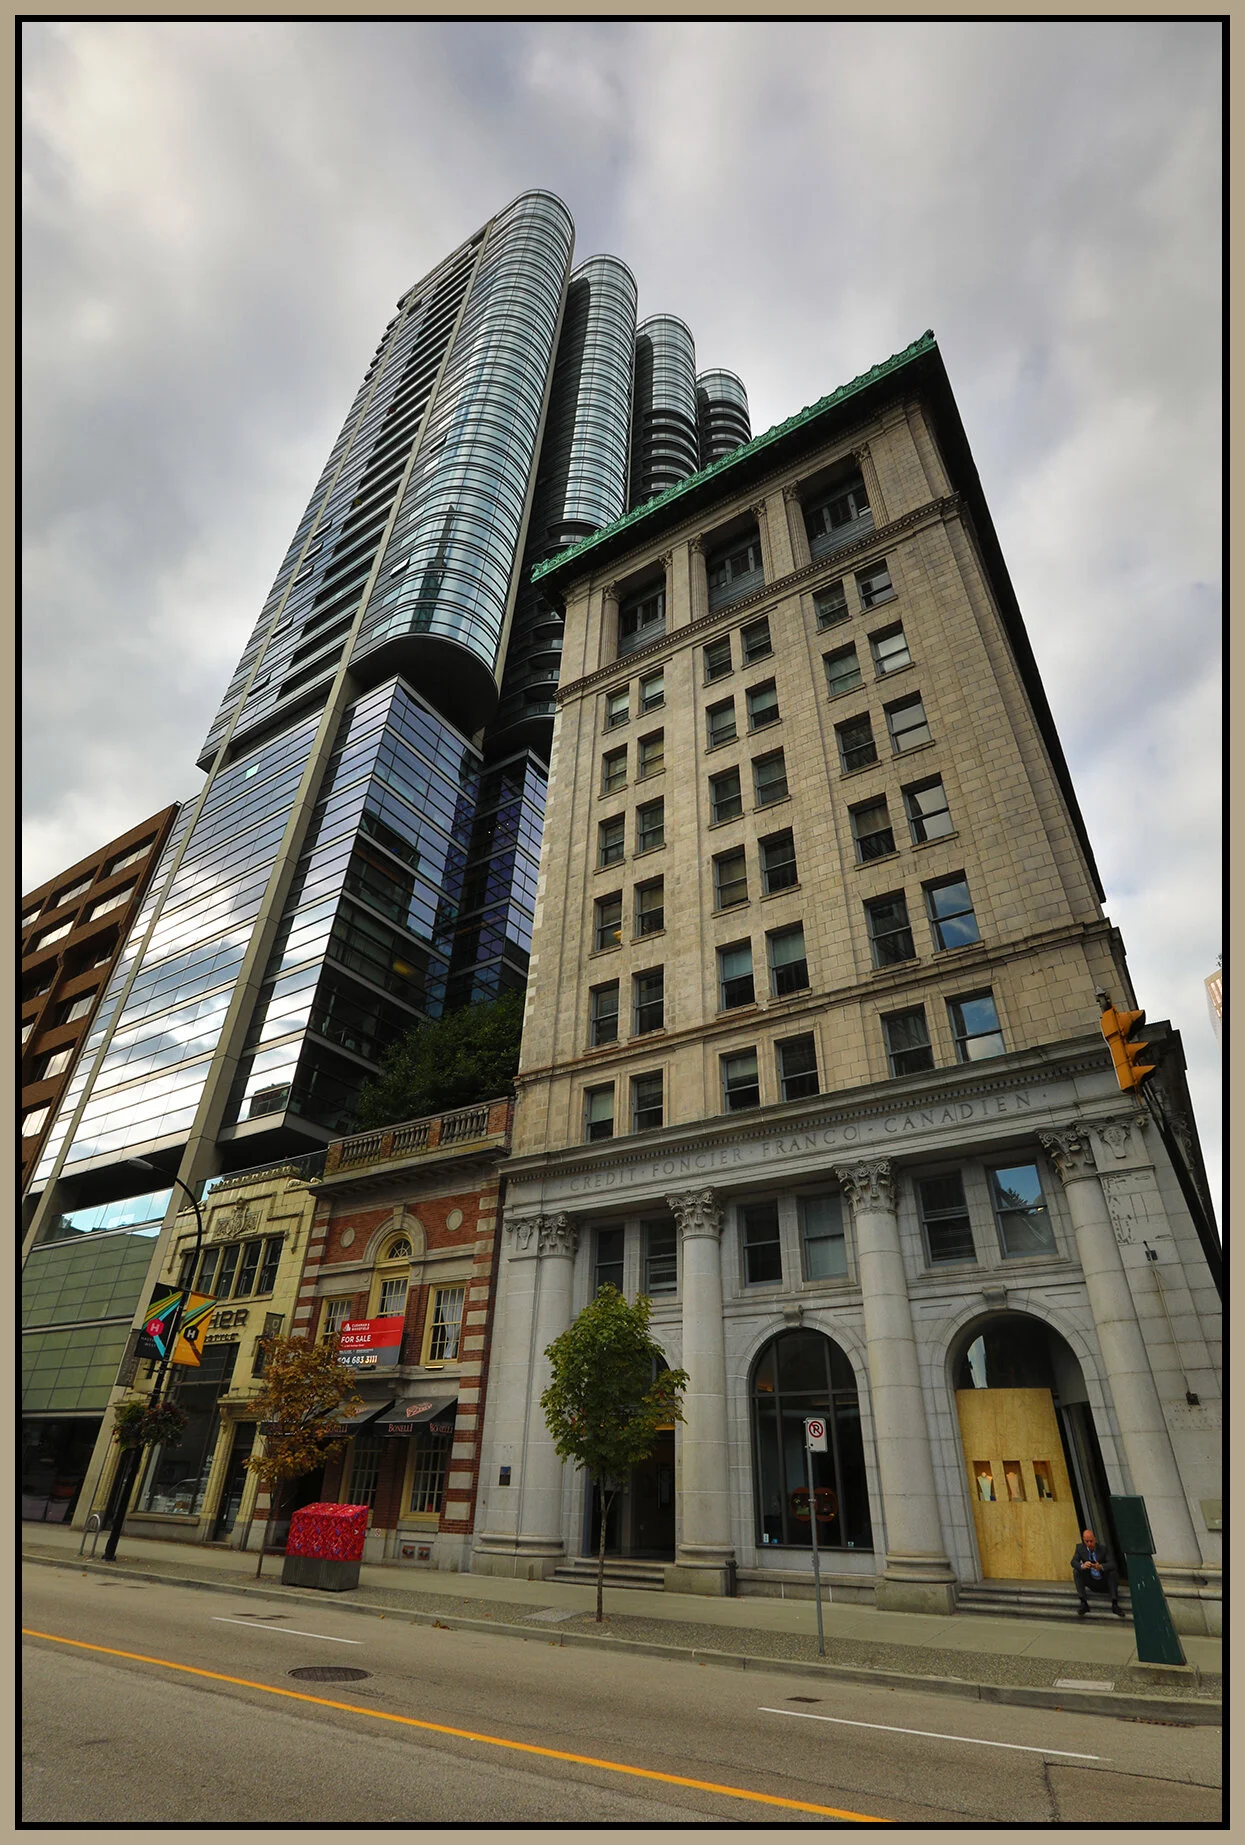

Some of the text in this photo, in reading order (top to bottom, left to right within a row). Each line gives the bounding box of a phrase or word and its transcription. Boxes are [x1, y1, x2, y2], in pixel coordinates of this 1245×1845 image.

[569, 1090, 1033, 1192] CREDIT FONCIER FRANCO CANADIEN
[356, 1335, 372, 1343] SALE
[351, 1355, 364, 1364] 683
[365, 1355, 378, 1364] 3111
[388, 1422, 413, 1433] BONELLI
